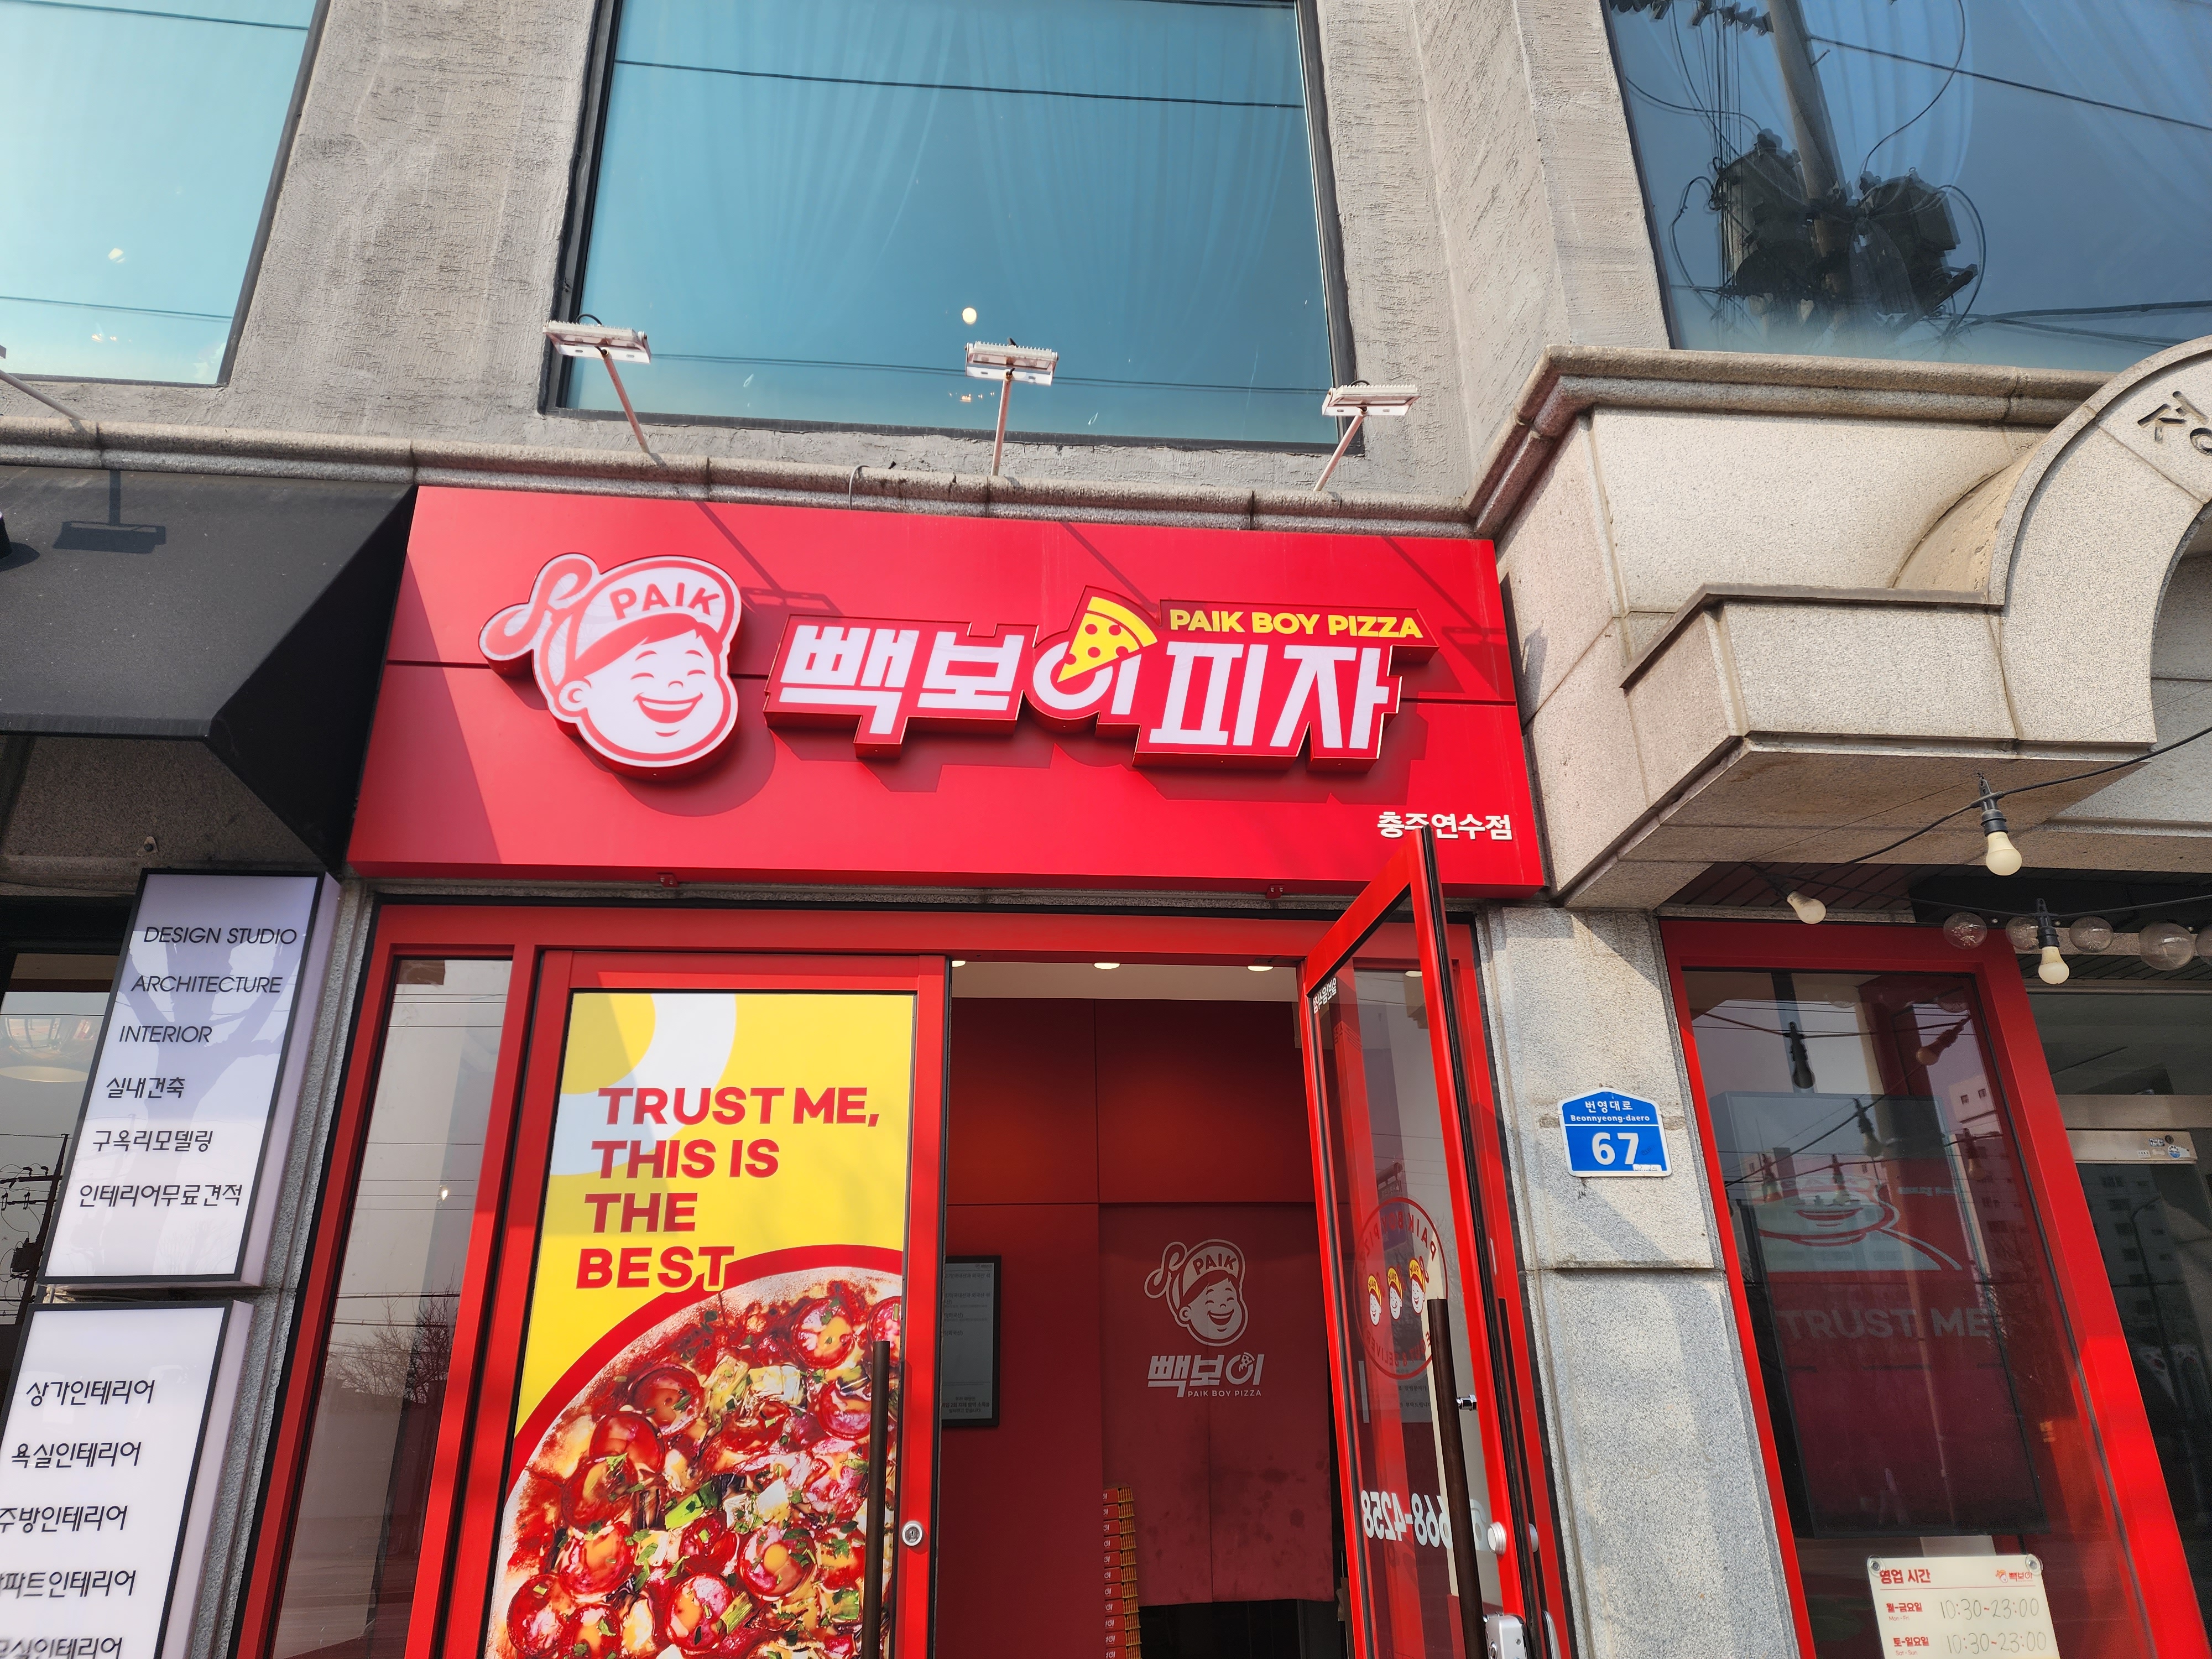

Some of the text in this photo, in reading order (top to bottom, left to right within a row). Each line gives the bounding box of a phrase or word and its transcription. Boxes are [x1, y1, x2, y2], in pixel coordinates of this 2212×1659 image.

[609, 582, 721, 622] PAIK
[1170, 609, 1423, 639] PAIK BOY PIZZA
[1377, 811, 1512, 840] 충주연수점
[143, 926, 298, 945] DESIGN STUDIO
[131, 975, 283, 993] ARCHITECTURE
[119, 1025, 212, 1043] INTERIOR
[106, 1077, 186, 1099] 실내건축
[597, 1087, 880, 1128] TRUST ME,
[1570, 1114, 1650, 1123] Beonnyeong-daero
[1584, 1100, 1633, 1114] 번영대로
[92, 1130, 213, 1153] 구옥리모델링
[1592, 1132, 1639, 1165] 67
[591, 1139, 780, 1180] THIS IS
[79, 1185, 243, 1208] 인테리어무료견적
[584, 1192, 698, 1234] THE
[576, 1246, 735, 1290] BEST
[1193, 1253, 1237, 1276] PAIK
[1775, 1308, 1917, 1339] TRUST
[1147, 1352, 1265, 1397] 빽보이
[25, 1380, 155, 1407] 상가인테리어
[11, 1442, 142, 1469] 욕실인테리어
[0, 1505, 128, 1534] 주방인테리어
[0, 1570, 137, 1599] 파트인테리어
[1880, 1568, 1931, 1584] 영업 시간
[1886, 1602, 1923, 1613] 월-금요일
[1893, 1636, 1929, 1647] 토-일요일
